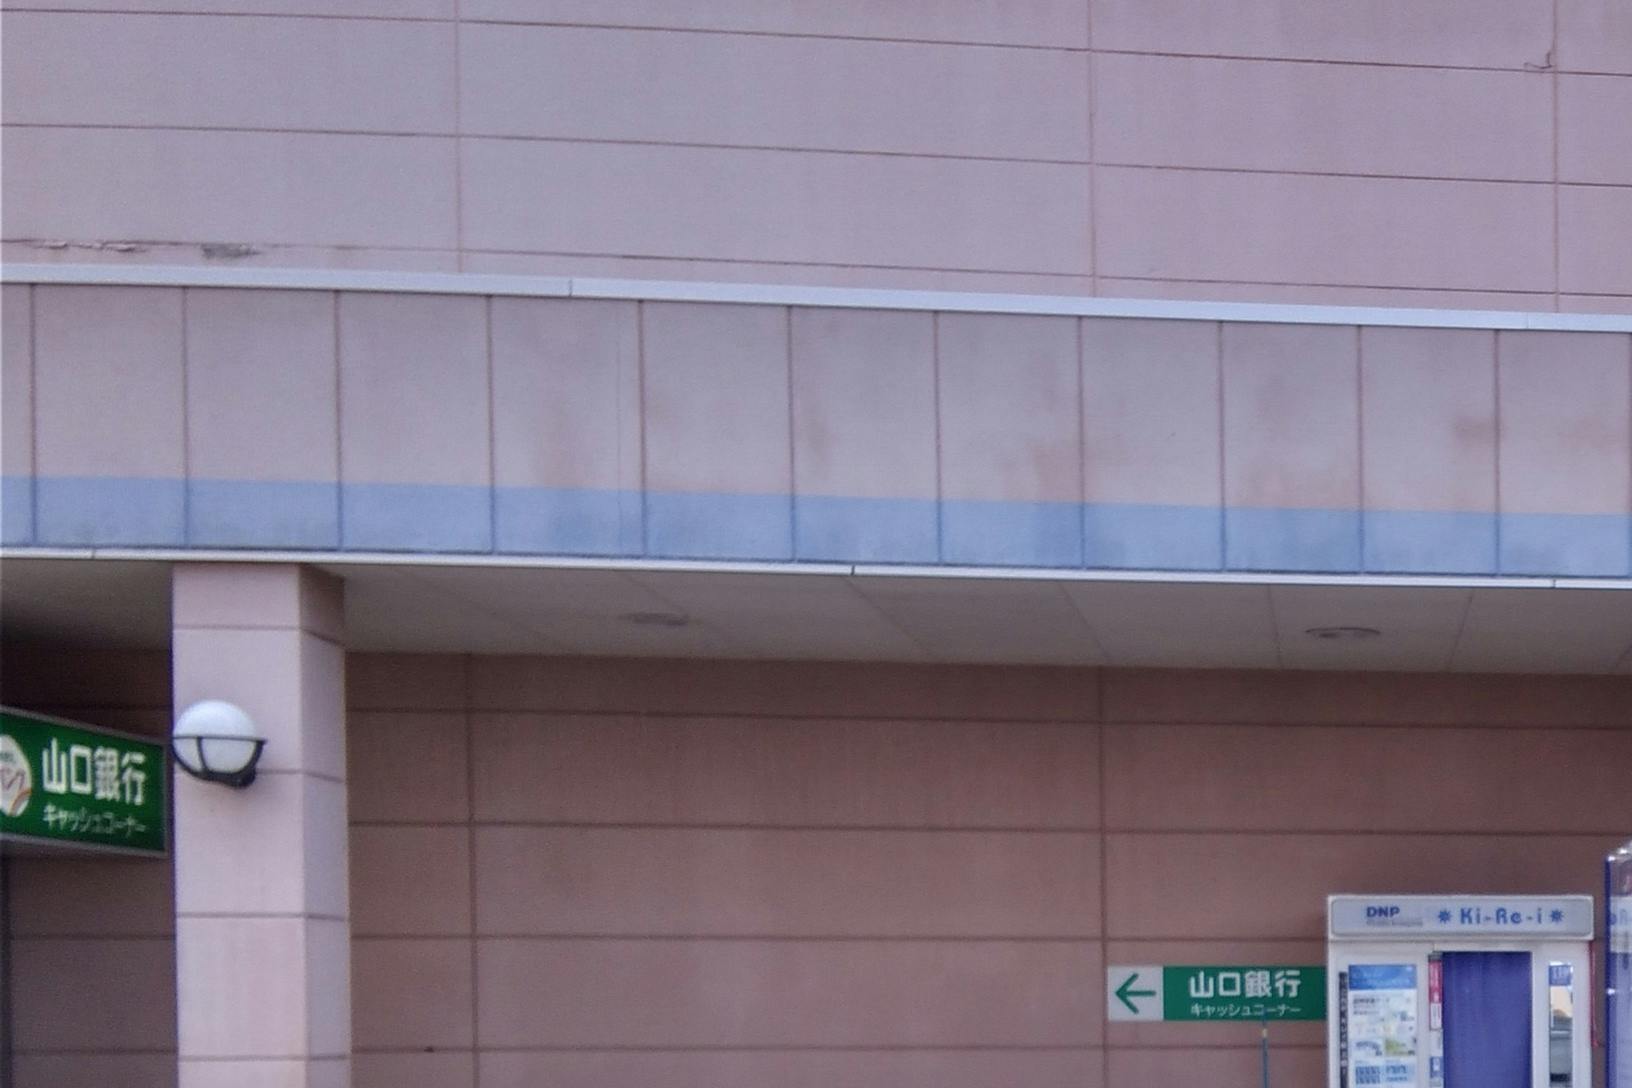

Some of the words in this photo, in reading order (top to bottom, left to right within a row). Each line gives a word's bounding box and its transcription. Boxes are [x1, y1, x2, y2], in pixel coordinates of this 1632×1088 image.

[42, 737, 147, 806] 山口銀行
[1366, 906, 1400, 918] DNP
[1190, 969, 1302, 998] 山口銀行
